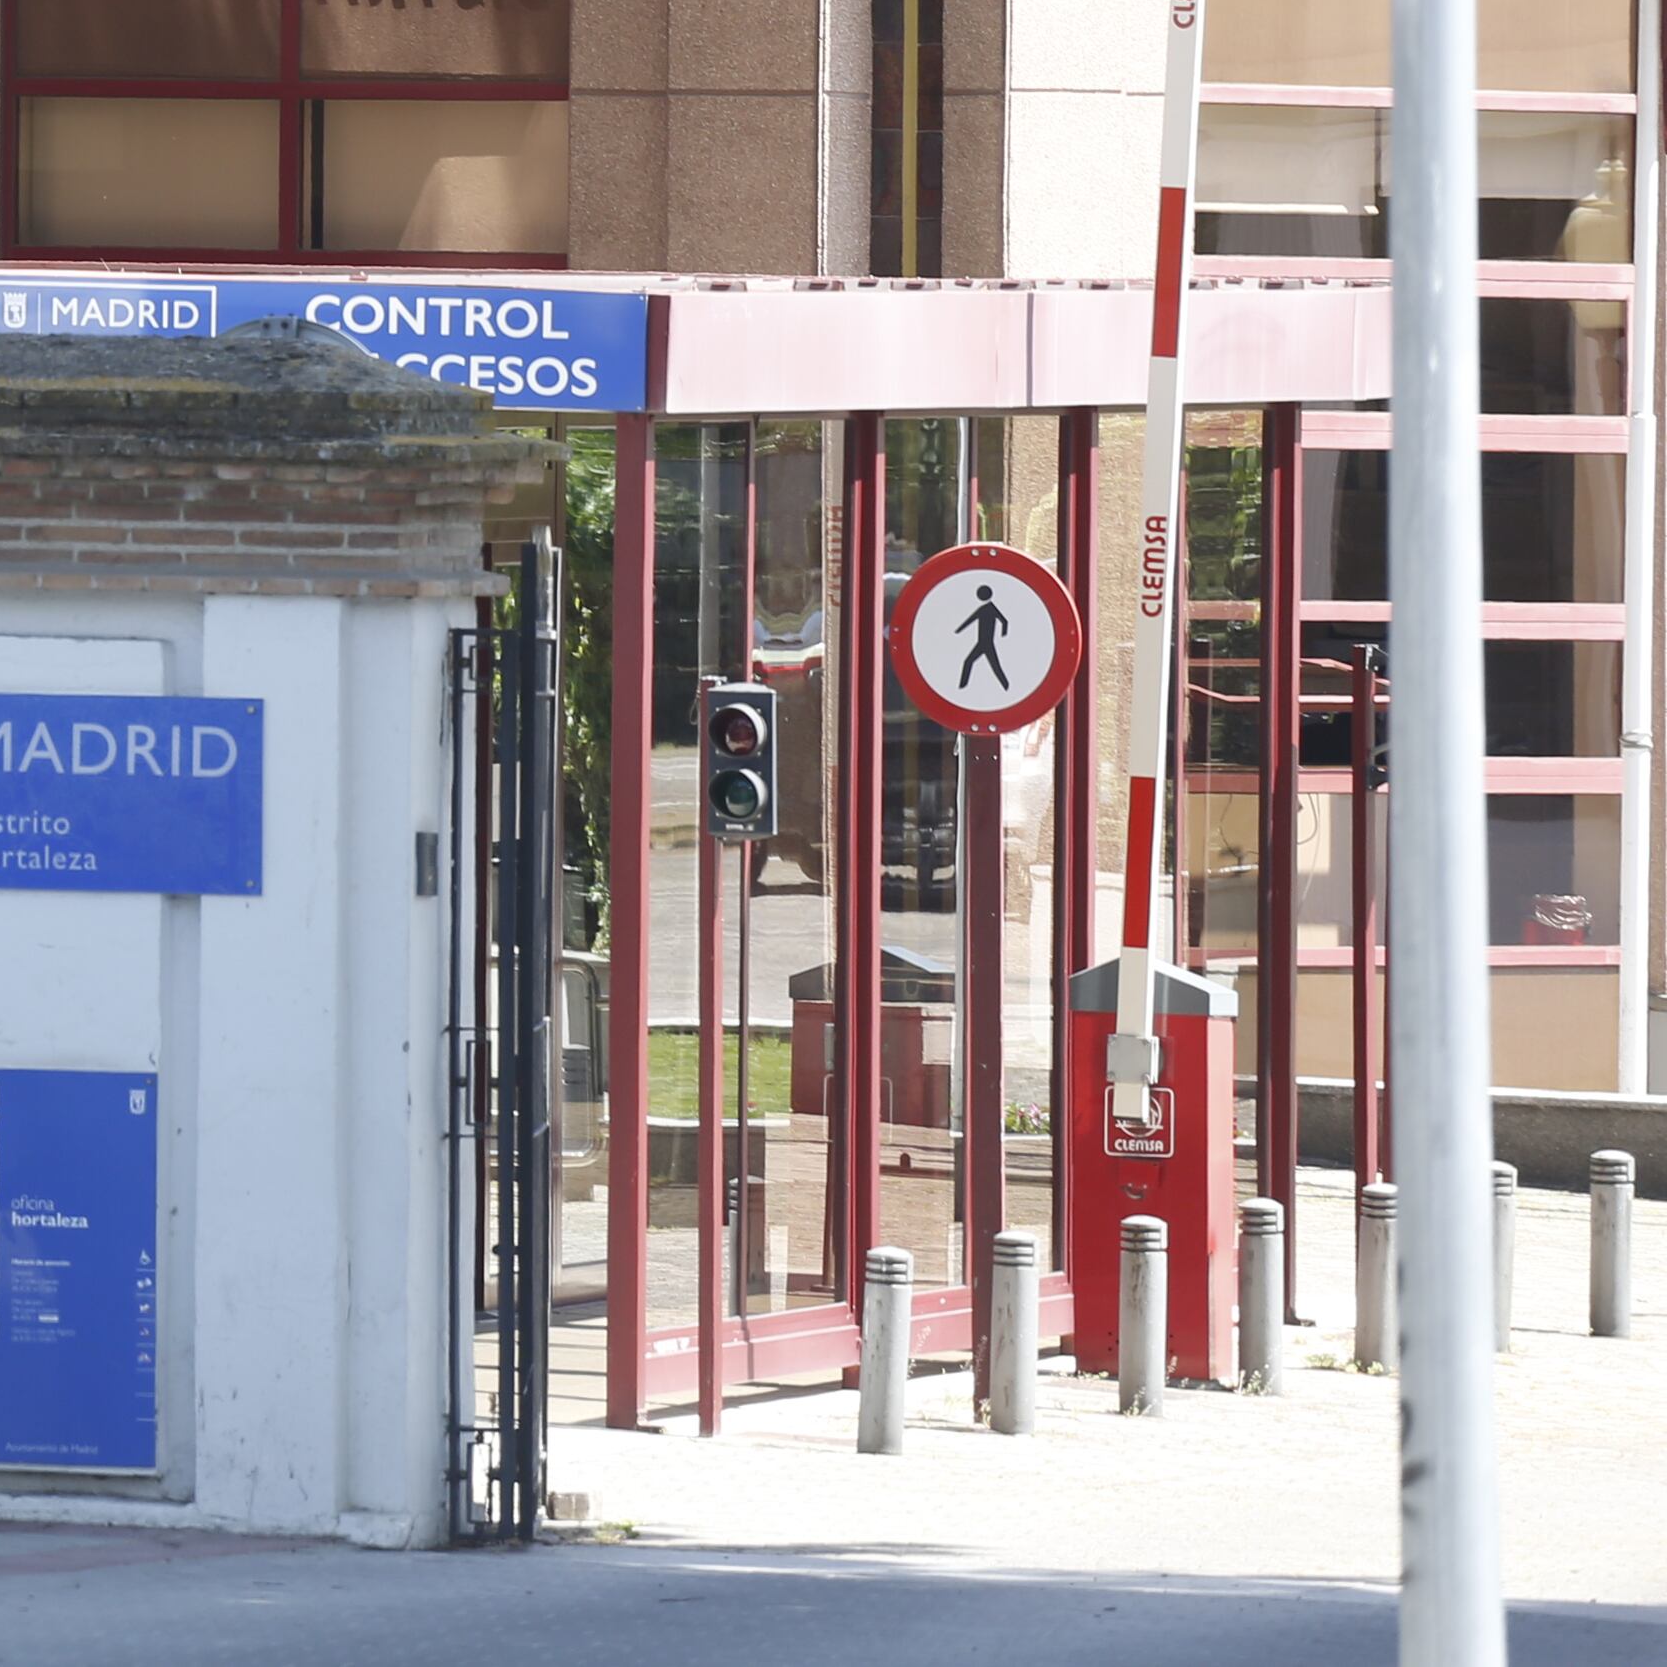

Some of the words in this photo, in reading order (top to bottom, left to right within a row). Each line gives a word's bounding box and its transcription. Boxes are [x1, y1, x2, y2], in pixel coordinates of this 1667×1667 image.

[51, 297, 200, 331] MADRID
[305, 294, 570, 340] CONTROL
[1141, 516, 1167, 617] CLEMSA
[1114, 1138, 1164, 1152] CLEMSA
[11, 1194, 54, 1211] oficina
[11, 1211, 89, 1229] hortaleza
